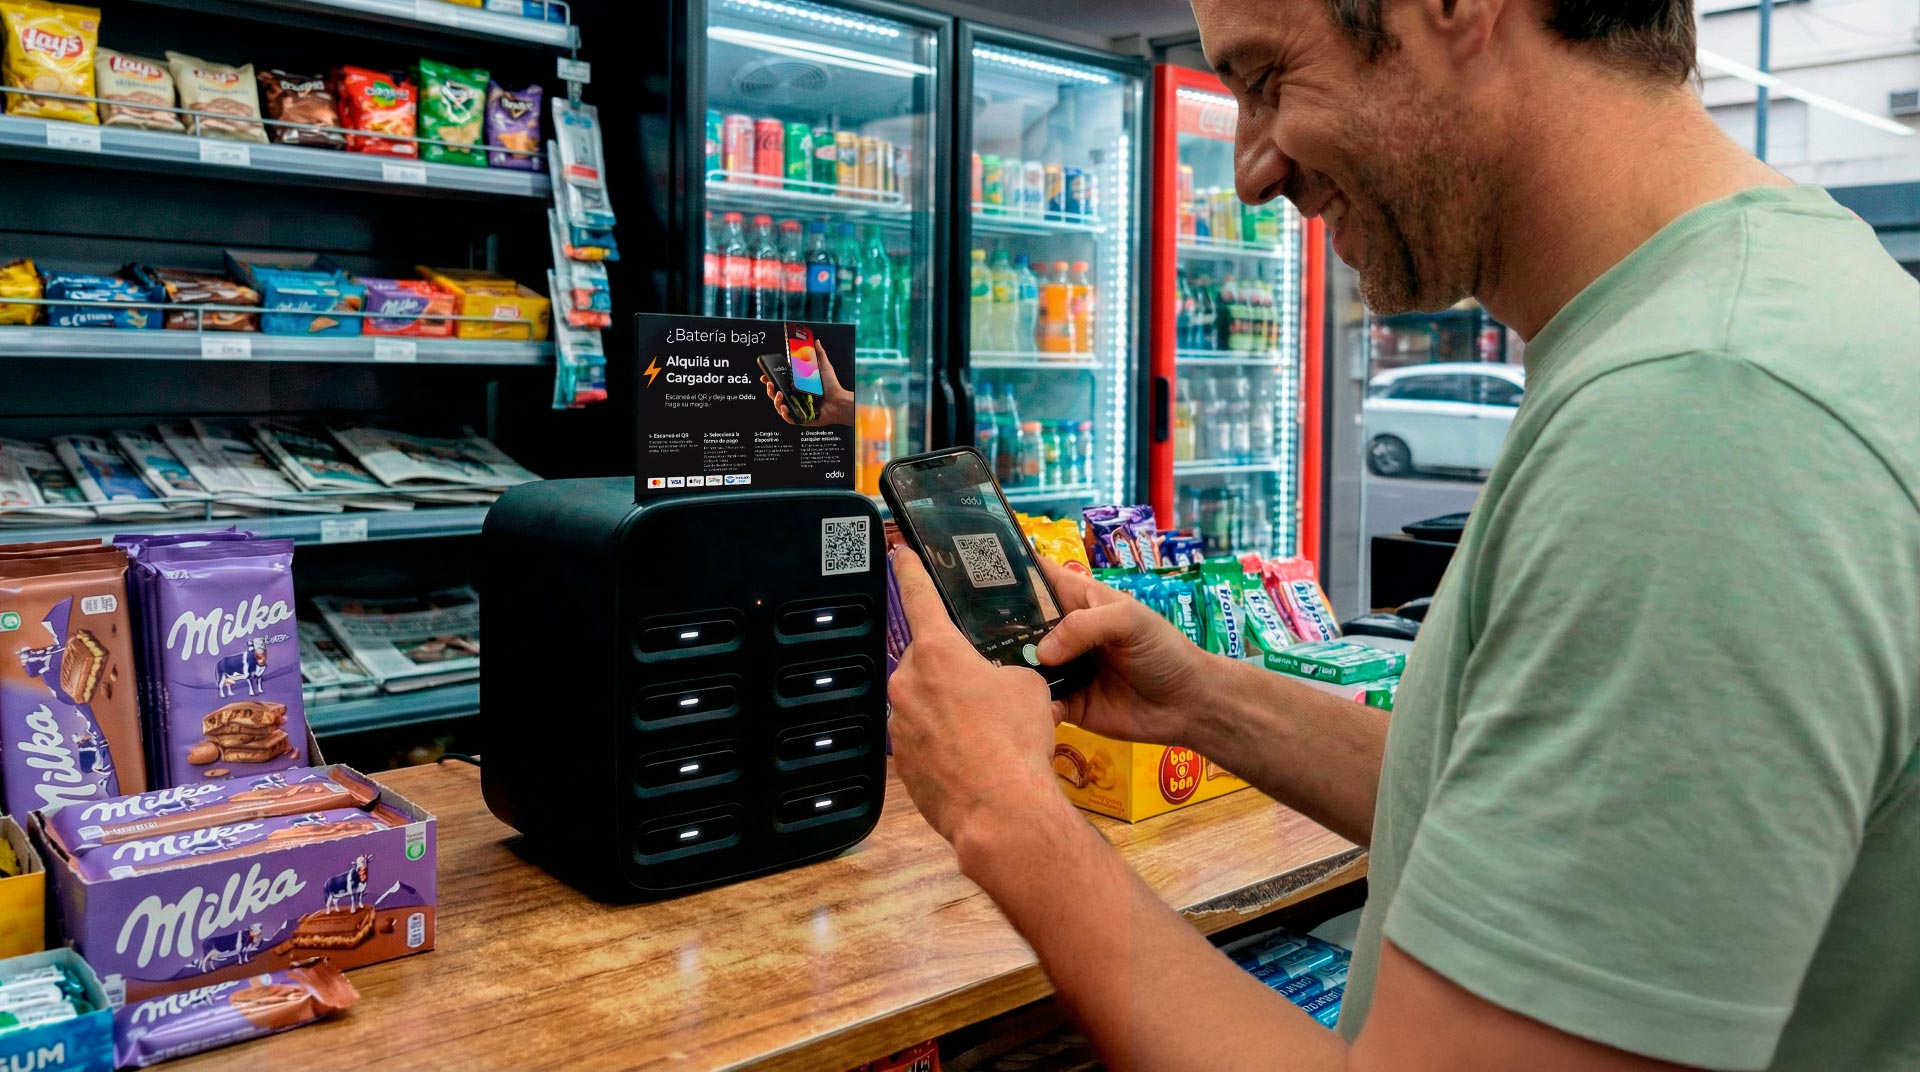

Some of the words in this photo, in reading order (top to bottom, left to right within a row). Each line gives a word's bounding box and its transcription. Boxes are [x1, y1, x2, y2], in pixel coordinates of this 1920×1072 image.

[666, 328, 726, 343] ¿Batería
[731, 331, 766, 346] baja?
[666, 355, 710, 368] Alquilá
[713, 358, 730, 368] un
[666, 372, 723, 386] Cargador
[727, 373, 752, 384] acá.
[825, 470, 845, 479] oddu
[960, 496, 982, 506] oddu
[166, 594, 294, 661] Milka
[1170, 749, 1194, 766] bon
[1170, 776, 1193, 793] bon
[80, 783, 226, 822] Milka
[112, 822, 265, 862] Milka
[115, 862, 307, 969] Milka
